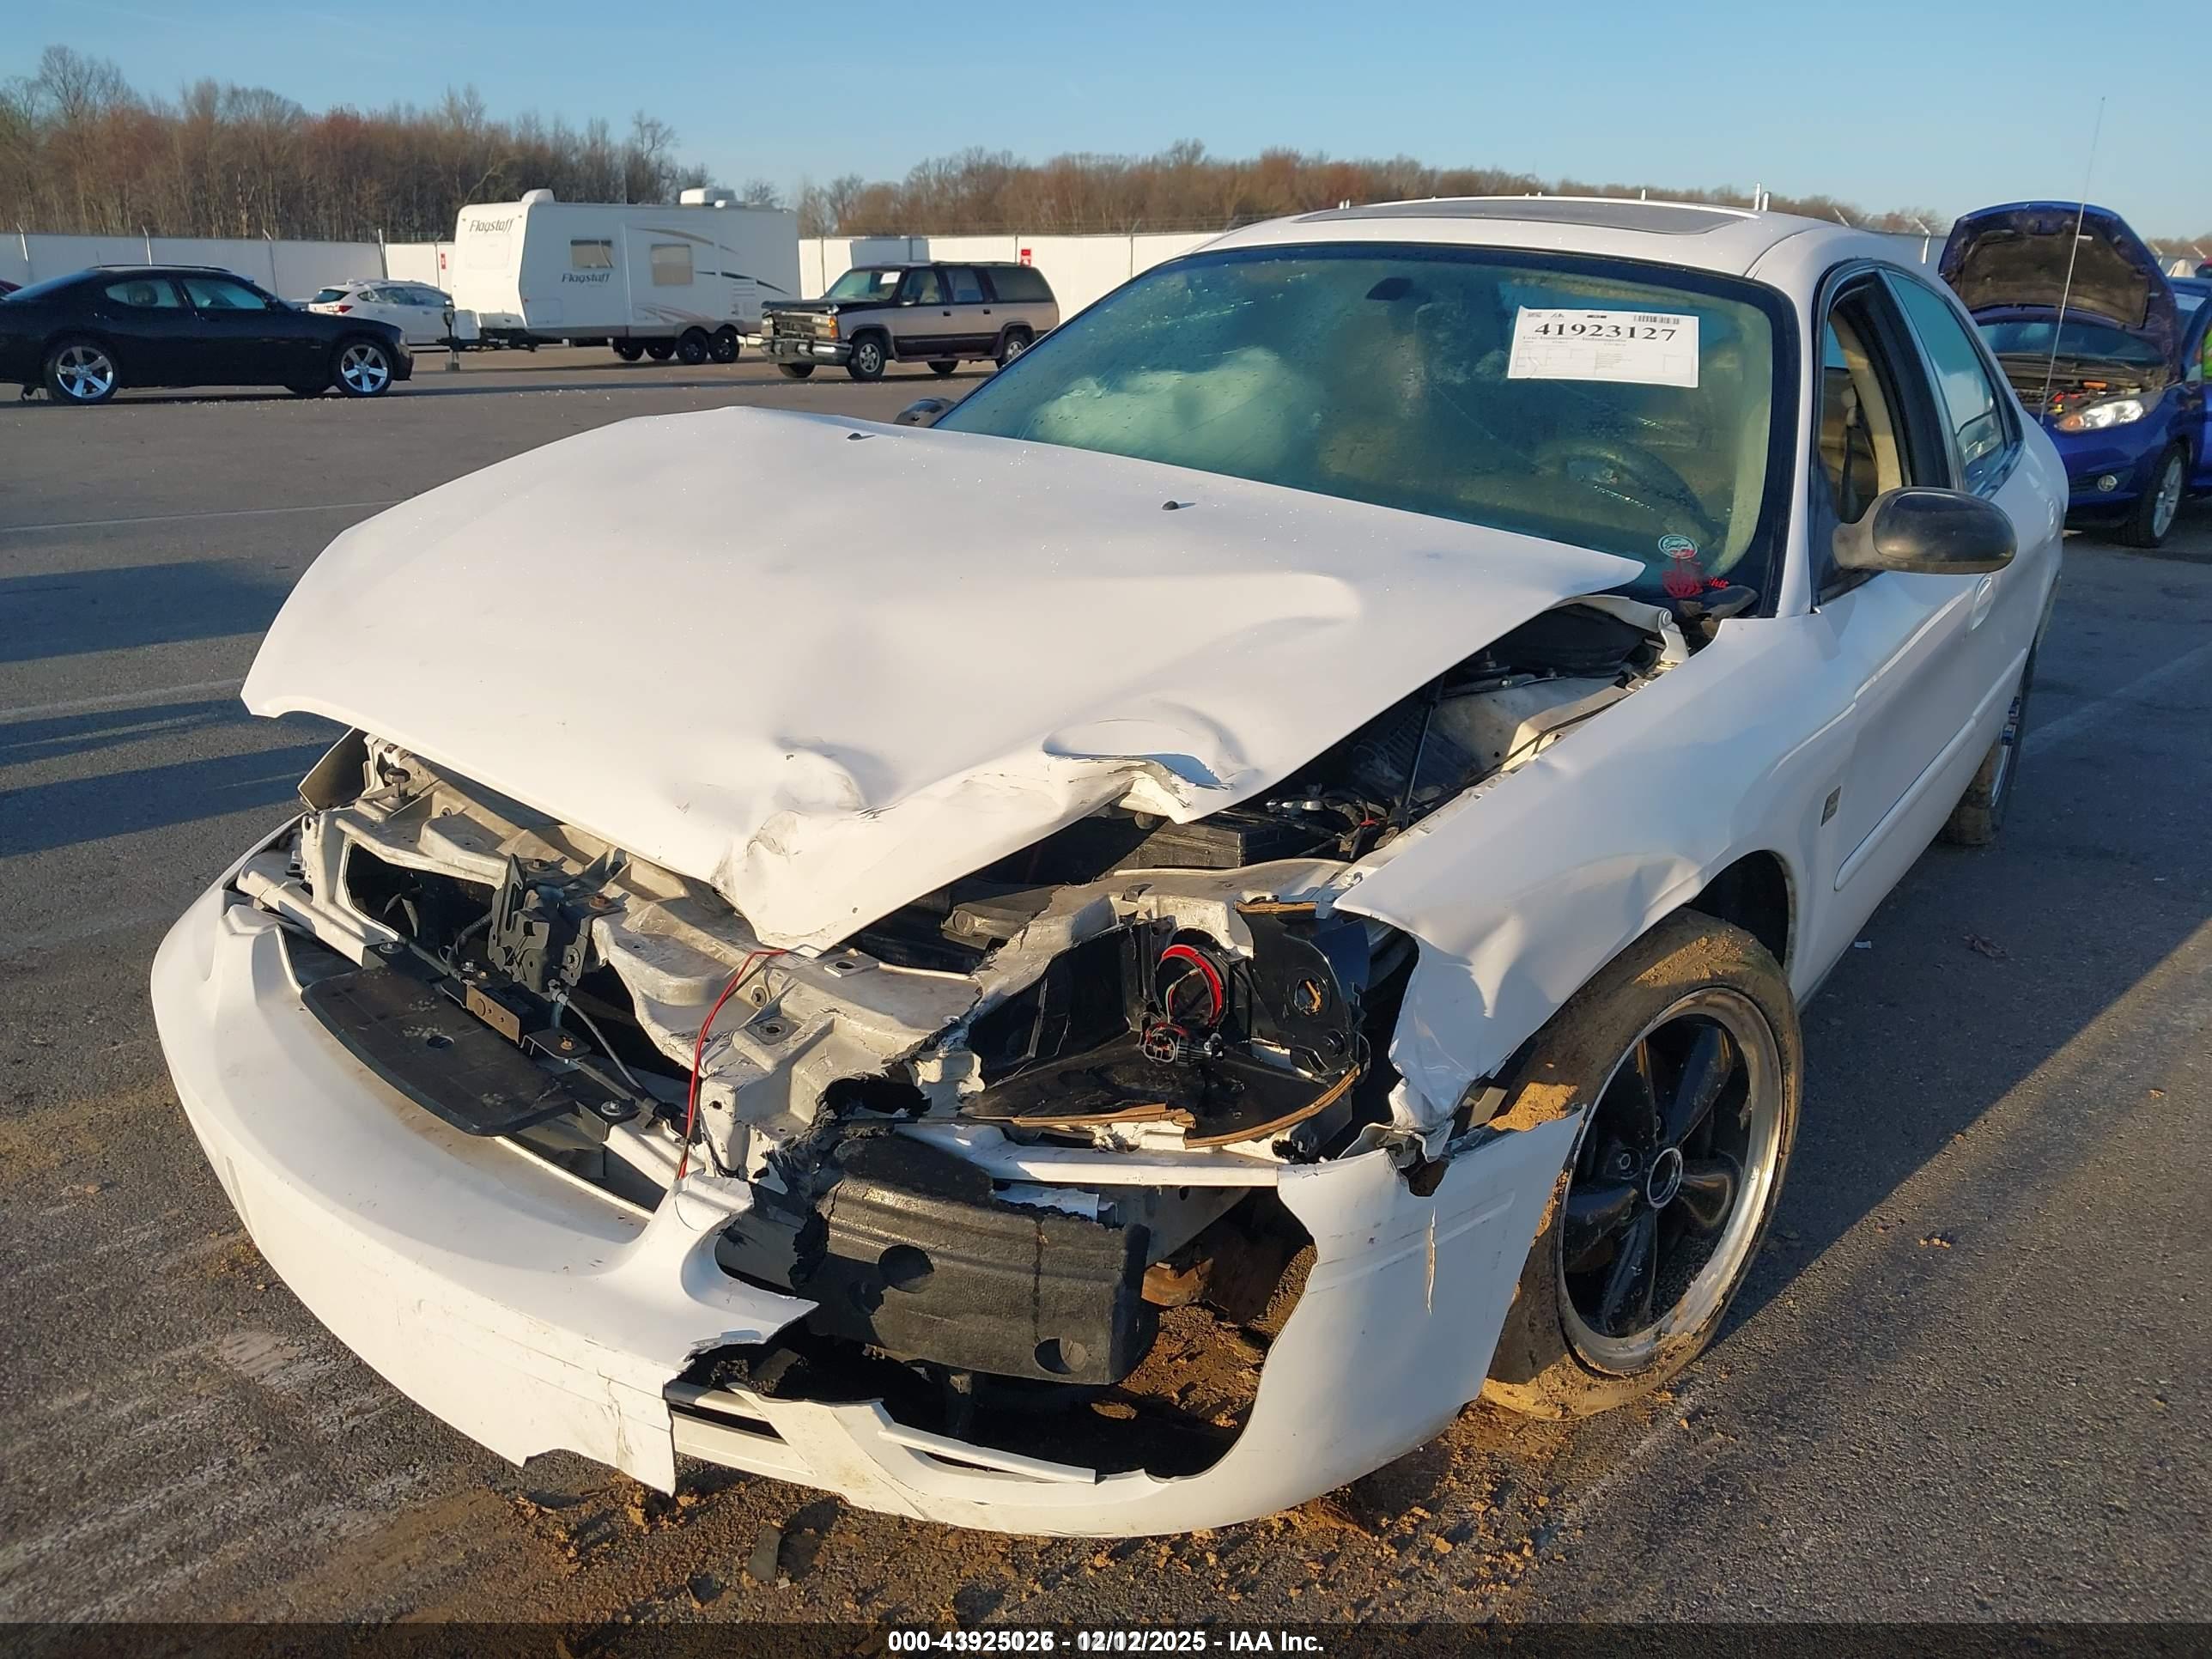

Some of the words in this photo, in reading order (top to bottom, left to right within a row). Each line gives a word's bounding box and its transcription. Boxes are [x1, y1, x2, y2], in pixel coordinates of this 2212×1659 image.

[469, 219, 514, 233] Flagstaff
[562, 273, 609, 283] Flagstaff
[1534, 322, 1676, 342] 41923127
